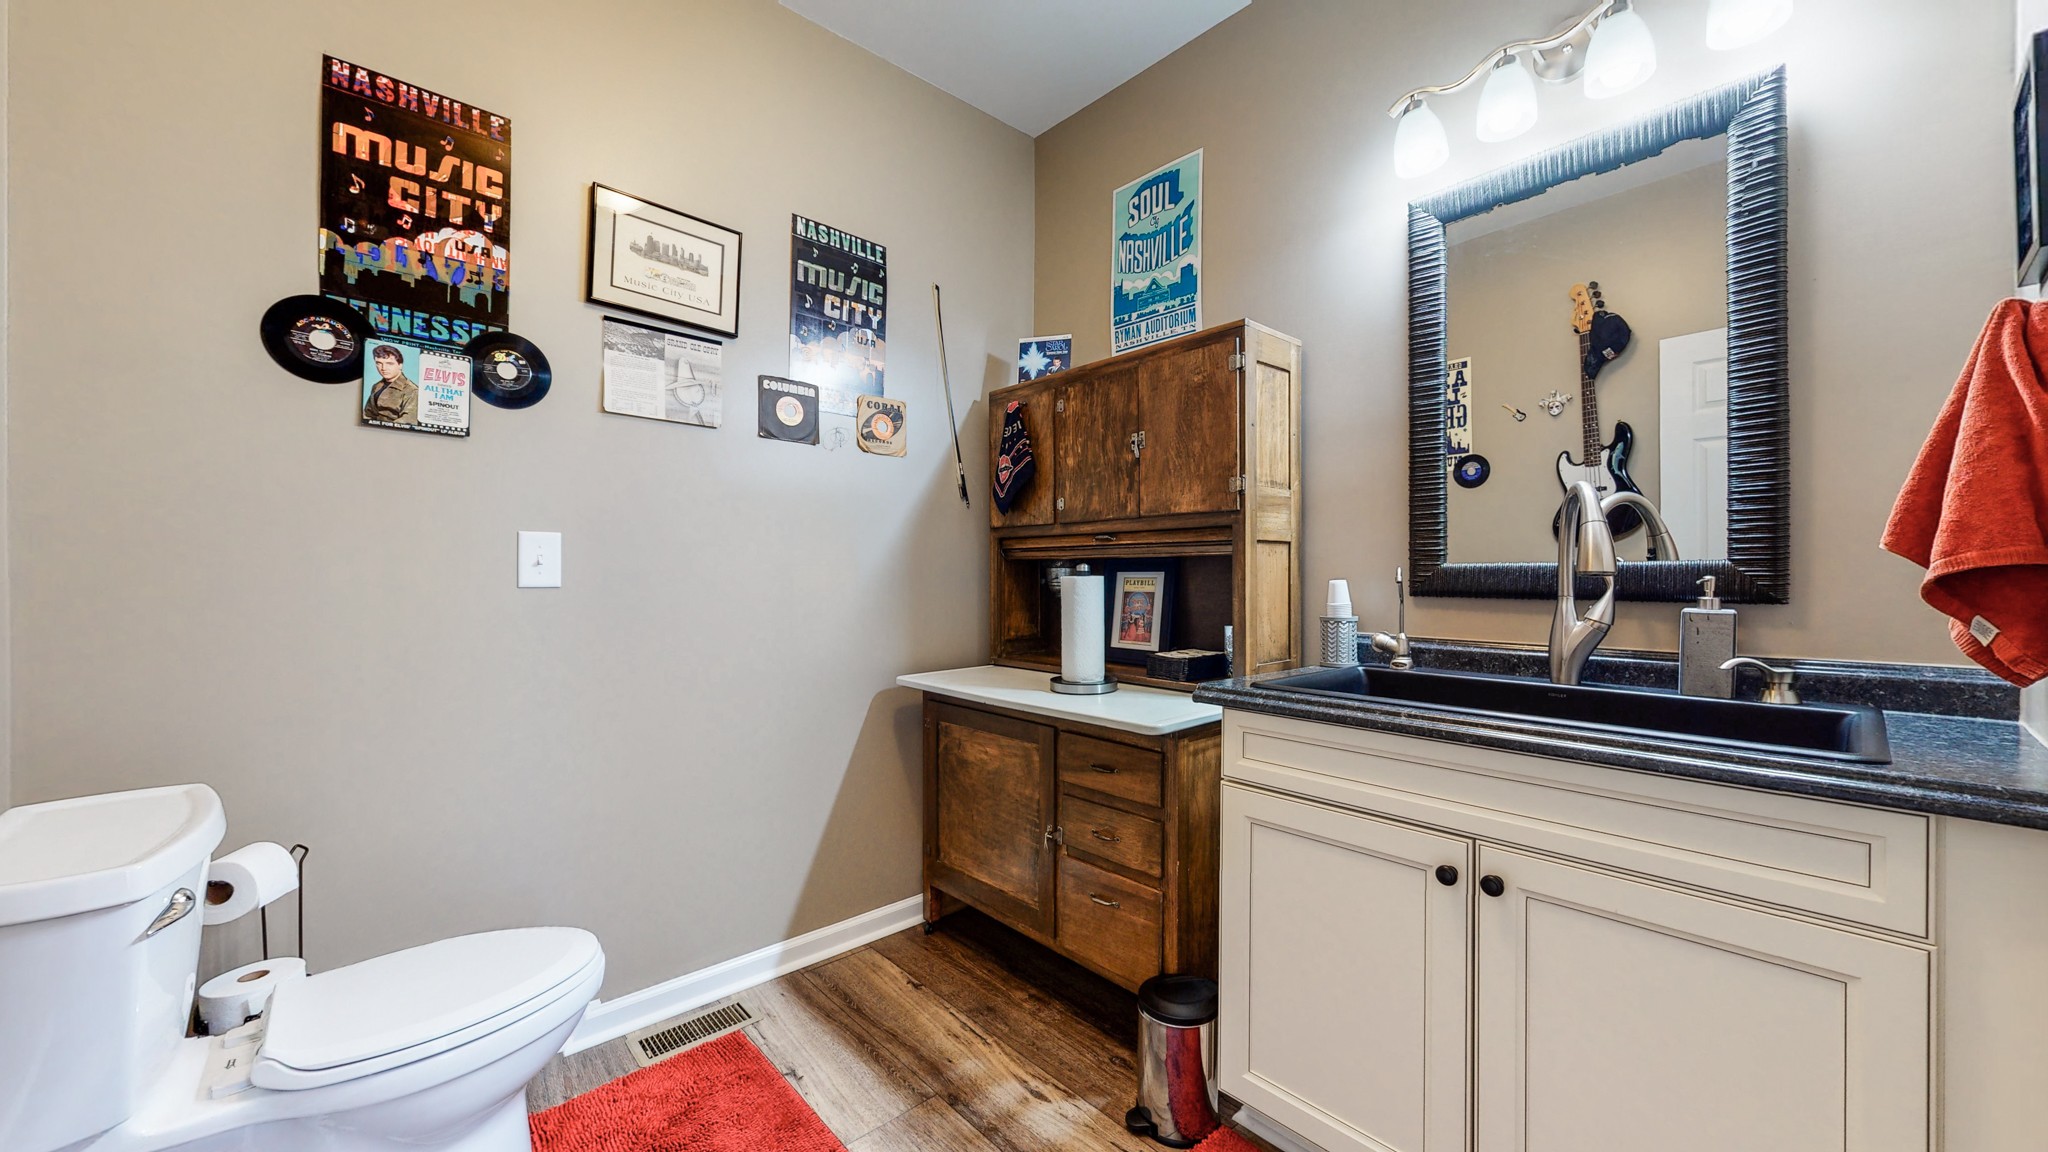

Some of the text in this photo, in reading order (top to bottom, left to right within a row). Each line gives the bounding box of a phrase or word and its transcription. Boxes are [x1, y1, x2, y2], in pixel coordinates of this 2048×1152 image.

[331, 58, 505, 142] NASHVILLE
[332, 121, 503, 200] MUSIC
[387, 175, 503, 233] CITY
[1128, 181, 1175, 229] SOUL
[455, 240, 491, 259] USA
[796, 216, 884, 264] NASHVILLE
[1118, 214, 1189, 273] NASHVILLE
[624, 275, 658, 291] Music
[662, 286, 683, 299] City
[689, 294, 710, 306] USA
[797, 259, 883, 305] MUSIC
[326, 294, 503, 346] NNESS
[824, 294, 882, 330] CITY
[1115, 307, 1196, 344] RYMAN AUDITORIUM
[1181, 323, 1196, 331] TN
[857, 336, 876, 348] USA
[424, 367, 466, 387] ELVIS
[424, 384, 439, 393] ALL
[441, 387, 464, 397] THAT
[763, 379, 816, 398] COLUMBIA
[428, 401, 459, 410] SPINOUT
[440, 393, 454, 401] AM
[867, 400, 903, 413] CORAL
